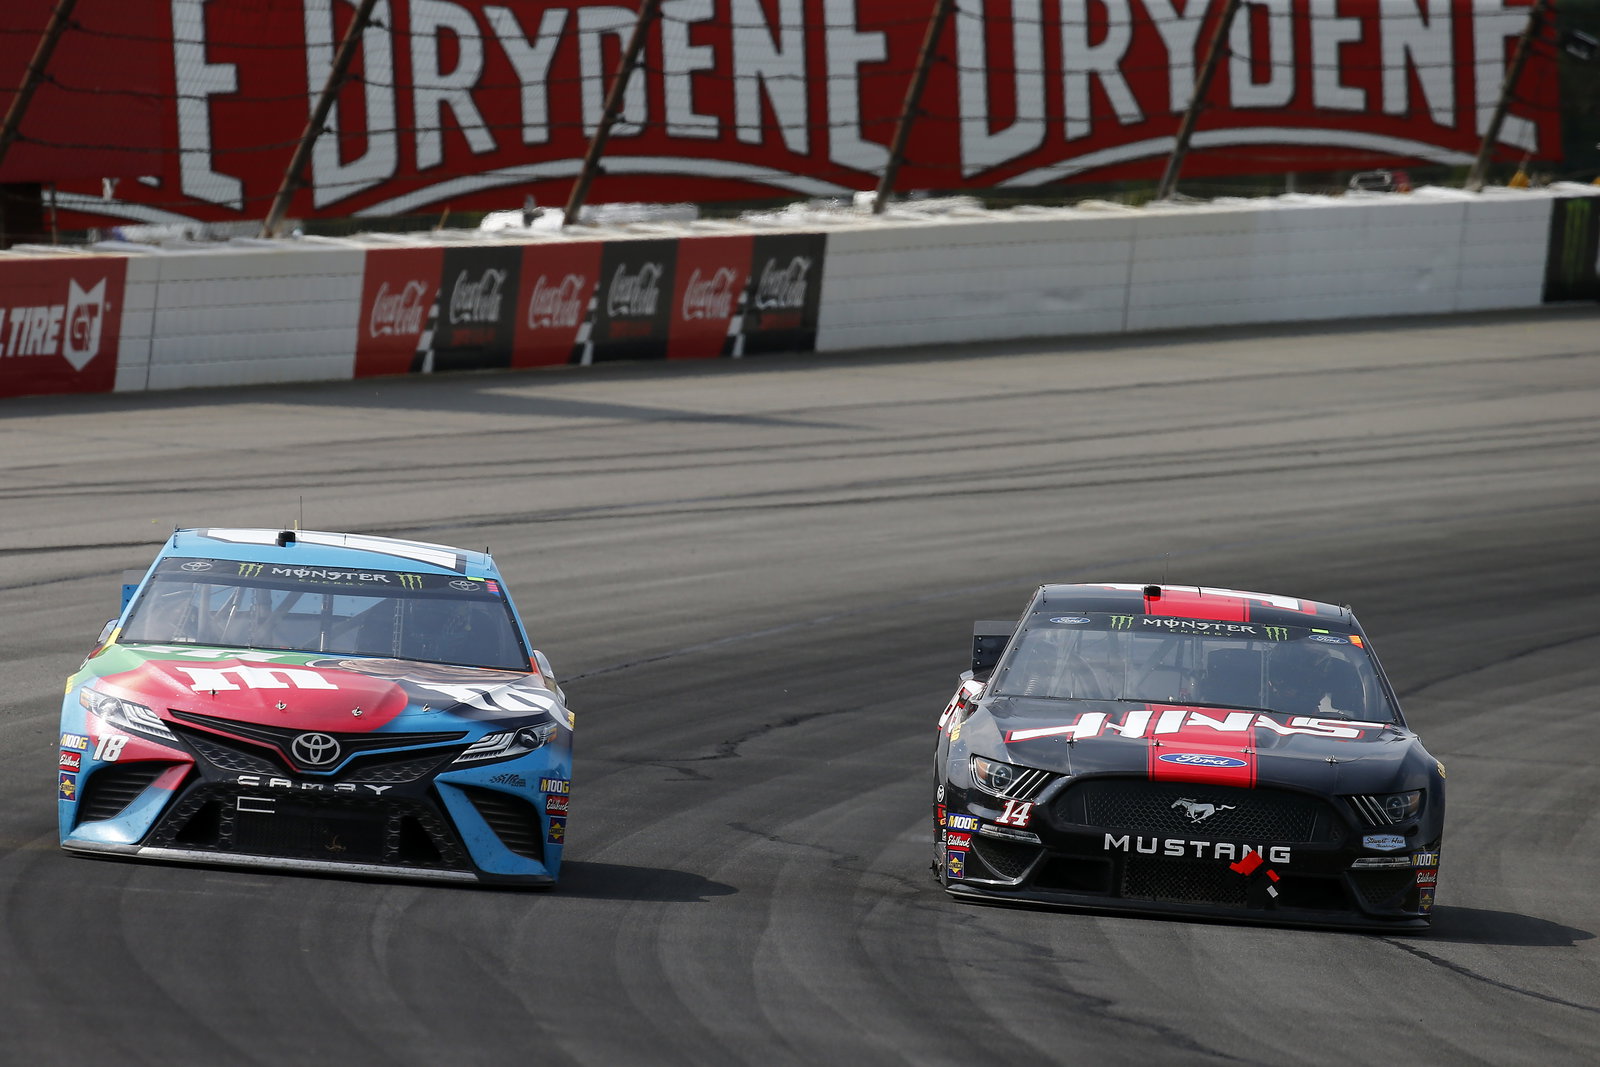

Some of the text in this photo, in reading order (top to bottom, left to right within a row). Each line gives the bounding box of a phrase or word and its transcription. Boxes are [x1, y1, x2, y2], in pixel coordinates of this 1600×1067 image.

[6, 304, 65, 357] TIRE
[61, 733, 88, 750] MOOG
[92, 733, 130, 762] 18
[540, 779, 569, 793] MOOG
[948, 815, 978, 830] MOOG
[996, 800, 1032, 826] 14
[1104, 833, 1291, 863] MUSTANG
[1411, 853, 1438, 866] MOOG
